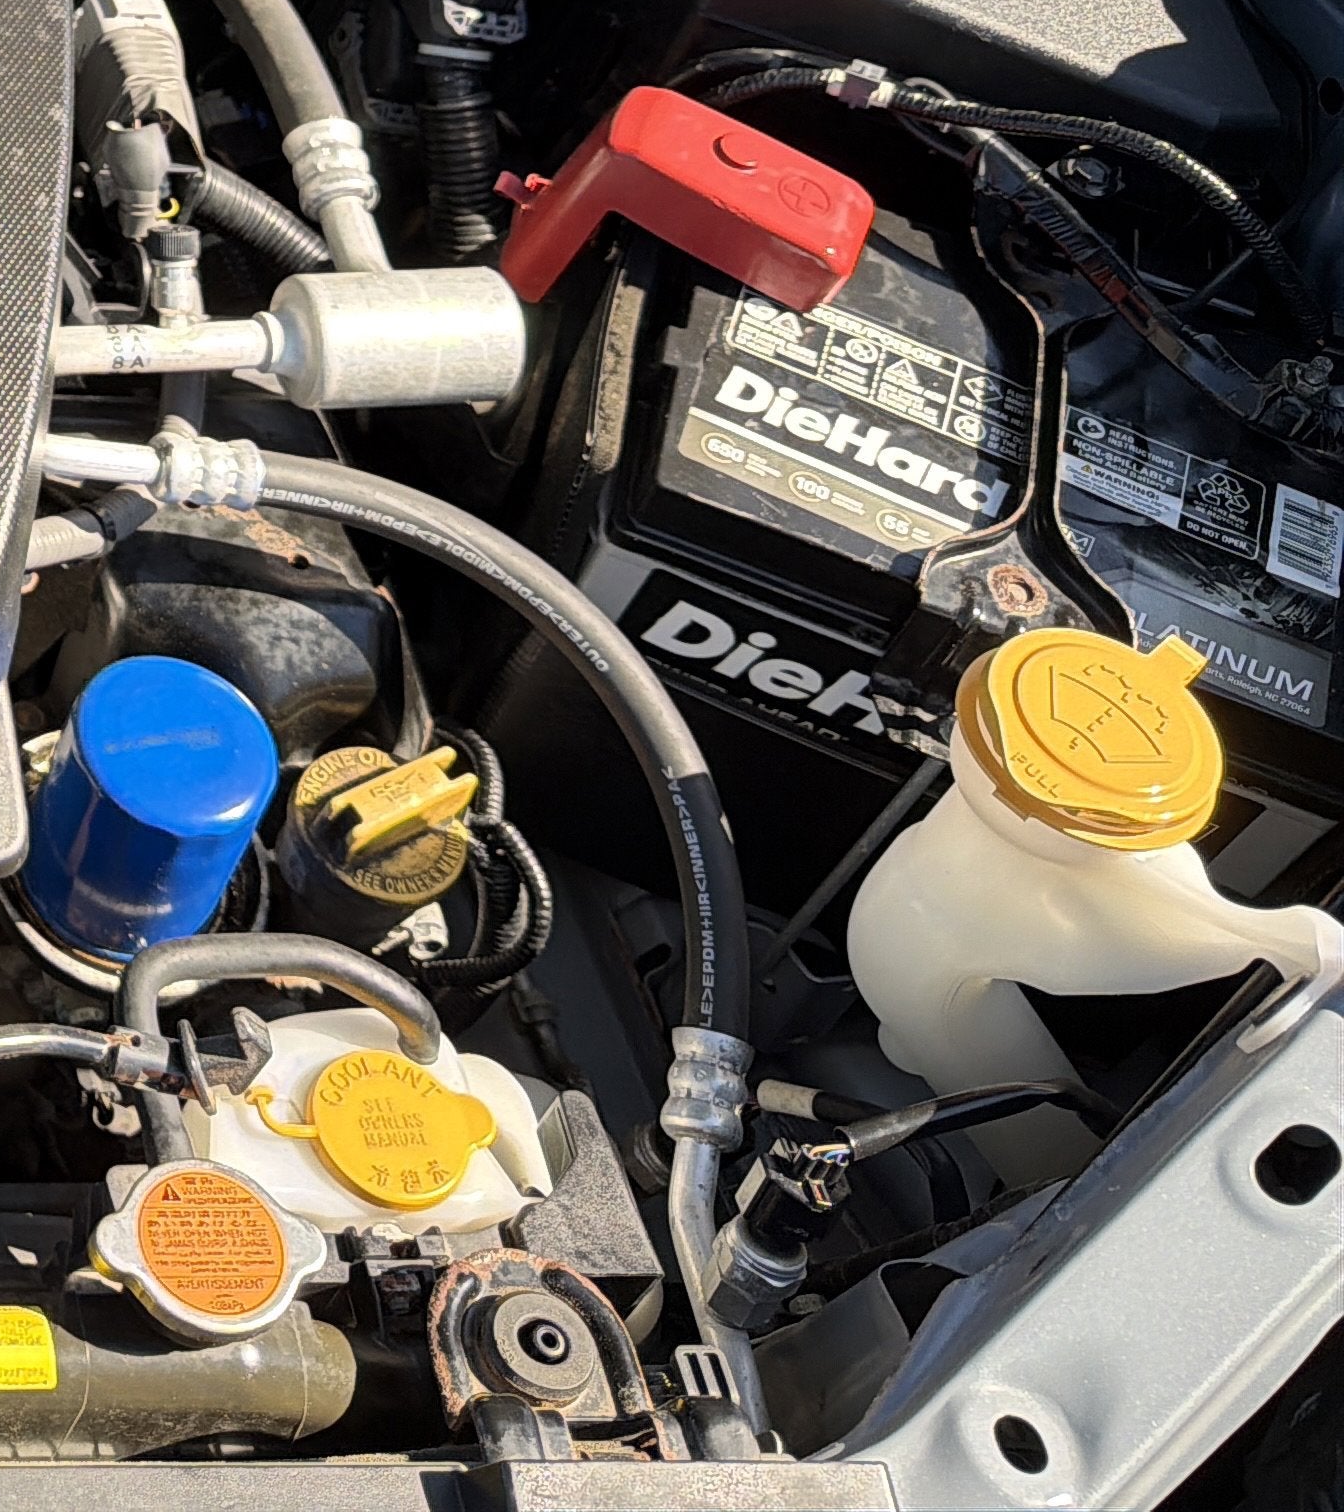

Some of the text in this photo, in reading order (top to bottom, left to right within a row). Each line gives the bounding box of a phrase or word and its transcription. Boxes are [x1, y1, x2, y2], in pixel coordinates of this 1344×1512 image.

[714, 365, 1011, 518] DieHard
[1072, 438, 1175, 487] NON-SPILLABLE
[793, 475, 830, 501] 100
[1078, 449, 1167, 491] Lead Acid Battery
[1186, 520, 1200, 532] DO
[1201, 524, 1219, 539] NOT
[640, 599, 884, 736] DieH
[1134, 608, 1315, 702] LATINUM
[1202, 666, 1226, 680] arts,
[1264, 690, 1279, 701] NC
[1278, 696, 1311, 715] 27064
[298, 749, 355, 804] ENGINE
[352, 867, 383, 890] SEE
[318, 1055, 443, 1106] COOLANT
